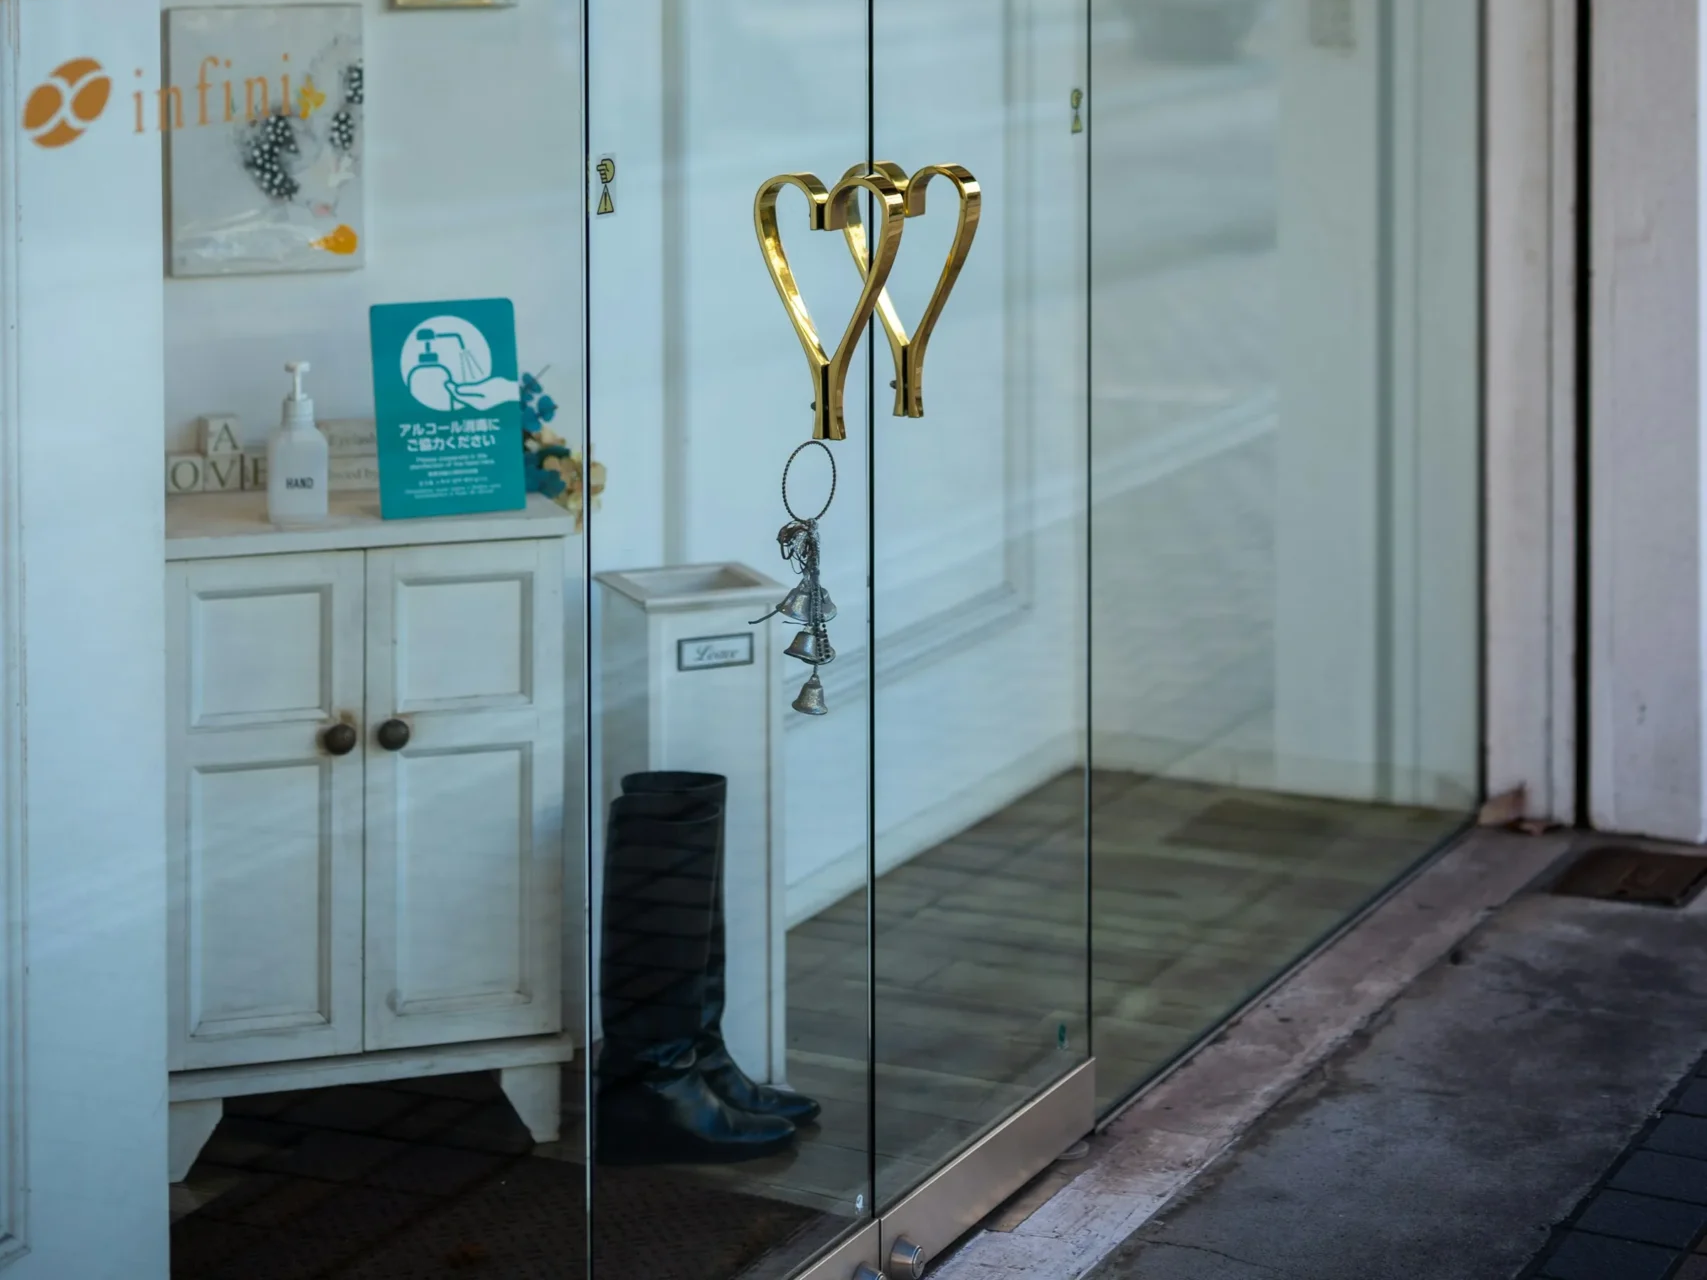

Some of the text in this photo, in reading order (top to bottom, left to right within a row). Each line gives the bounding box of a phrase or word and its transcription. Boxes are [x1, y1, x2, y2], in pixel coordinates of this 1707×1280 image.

[132, 52, 293, 135] infini
[213, 423, 239, 451] A
[285, 476, 314, 490] HAND
